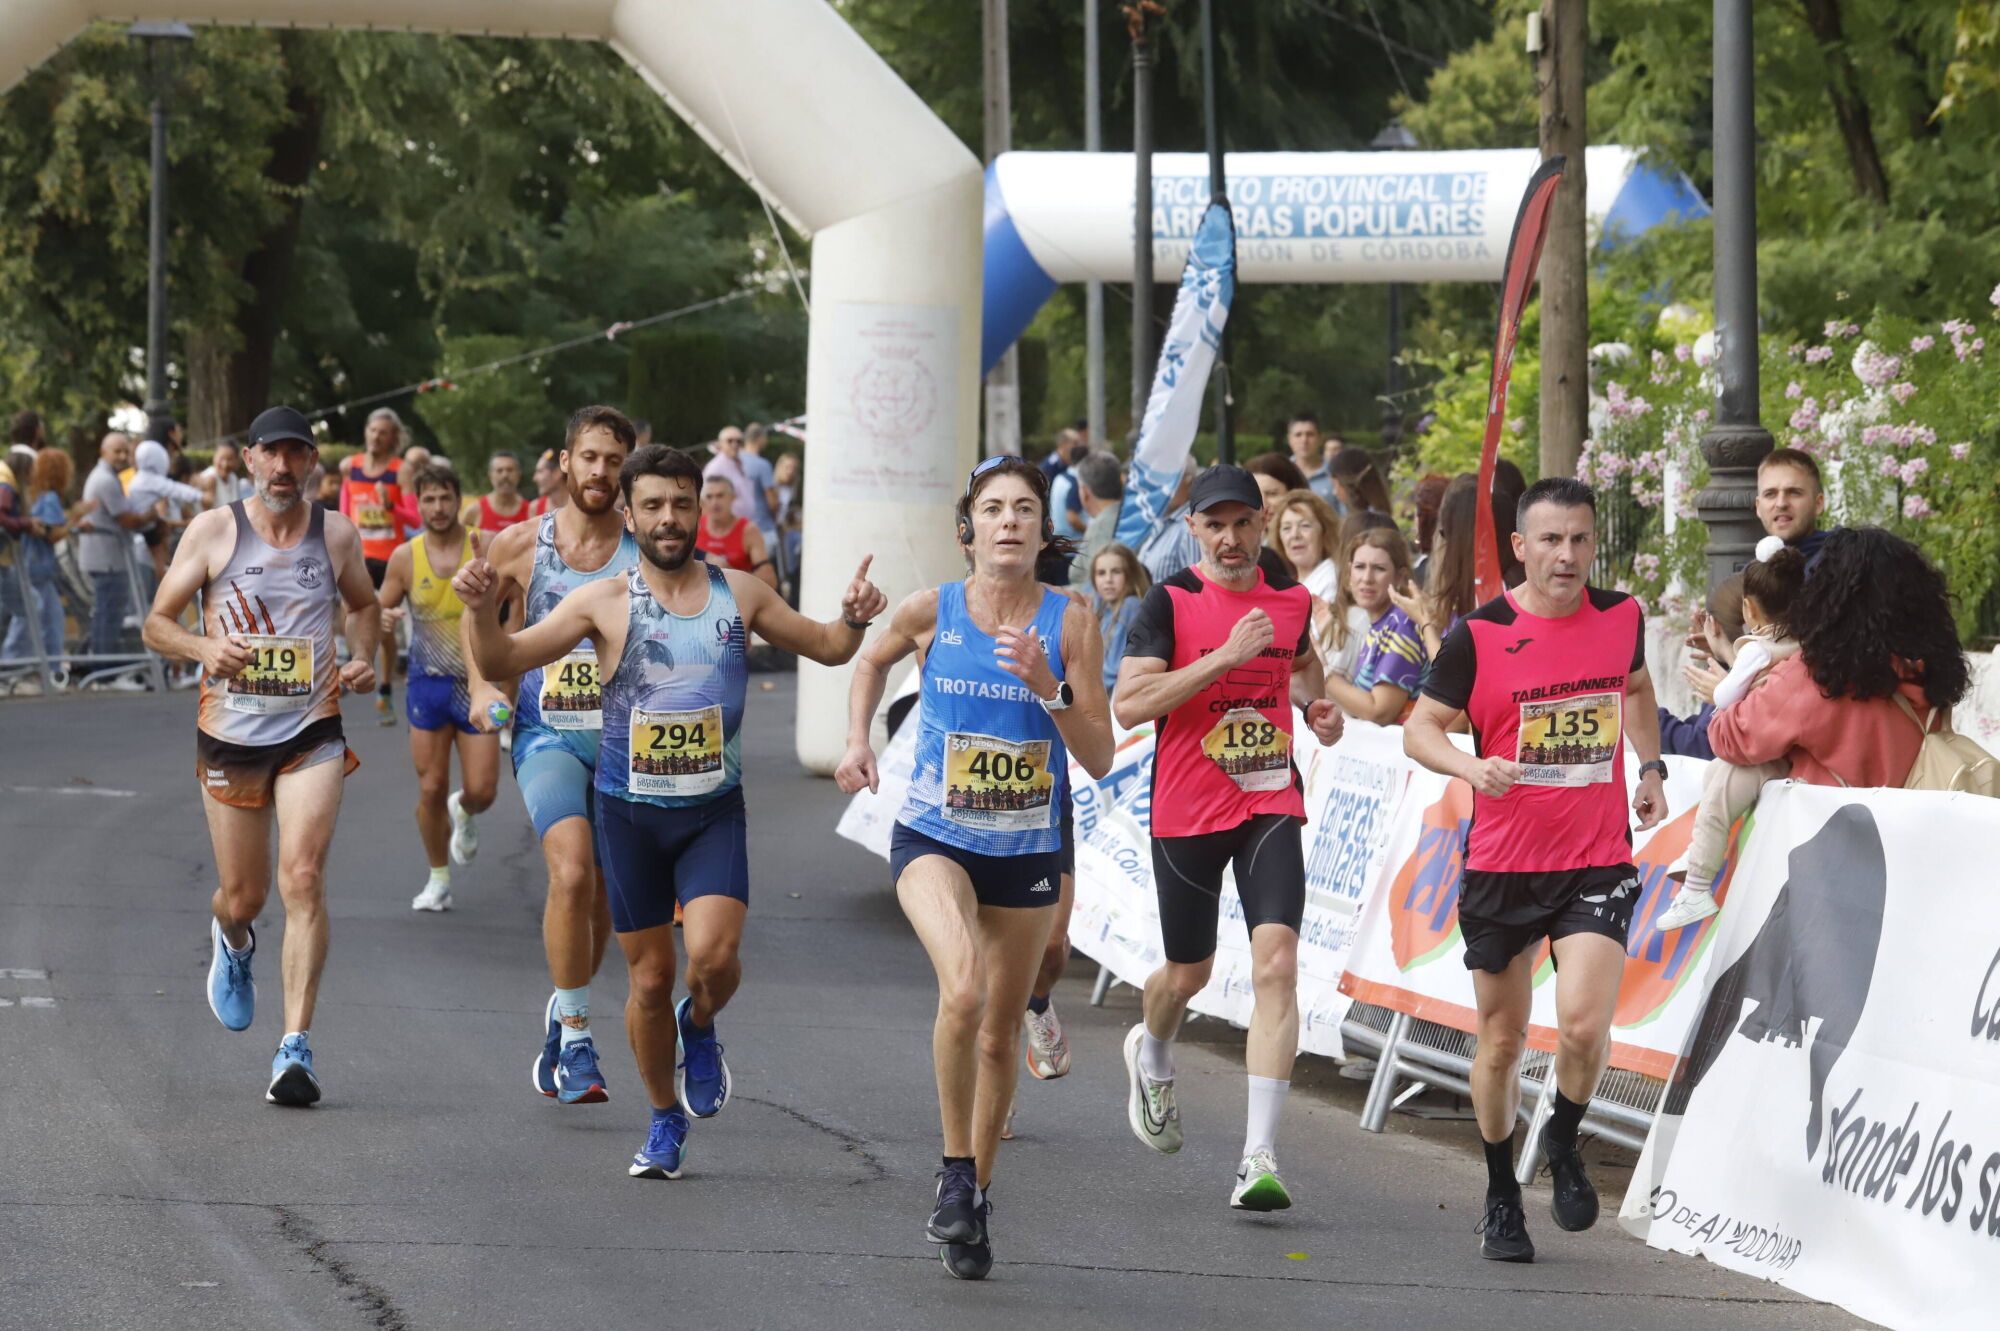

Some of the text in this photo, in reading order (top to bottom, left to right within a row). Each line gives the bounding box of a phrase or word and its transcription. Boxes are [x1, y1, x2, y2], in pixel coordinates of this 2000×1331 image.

[1270, 174, 1441, 204] PROVINCIAL
[1450, 174, 1488, 201] DE
[1303, 202, 1487, 237] POPULARES
[1311, 242, 1343, 262] DE
[248, 648, 296, 673] 419
[1200, 647, 1294, 660] TANNERS
[1511, 676, 1624, 703] TABLERUNNERS
[649, 723, 706, 749] 294
[1223, 721, 1277, 748] 188
[1544, 709, 1599, 738] 135
[951, 738, 970, 752] 39
[969, 751, 1035, 782] 406
[1594, 907, 1628, 931] NIK
[1904, 1109, 1973, 1224] los
[1672, 1206, 1702, 1230] DE
